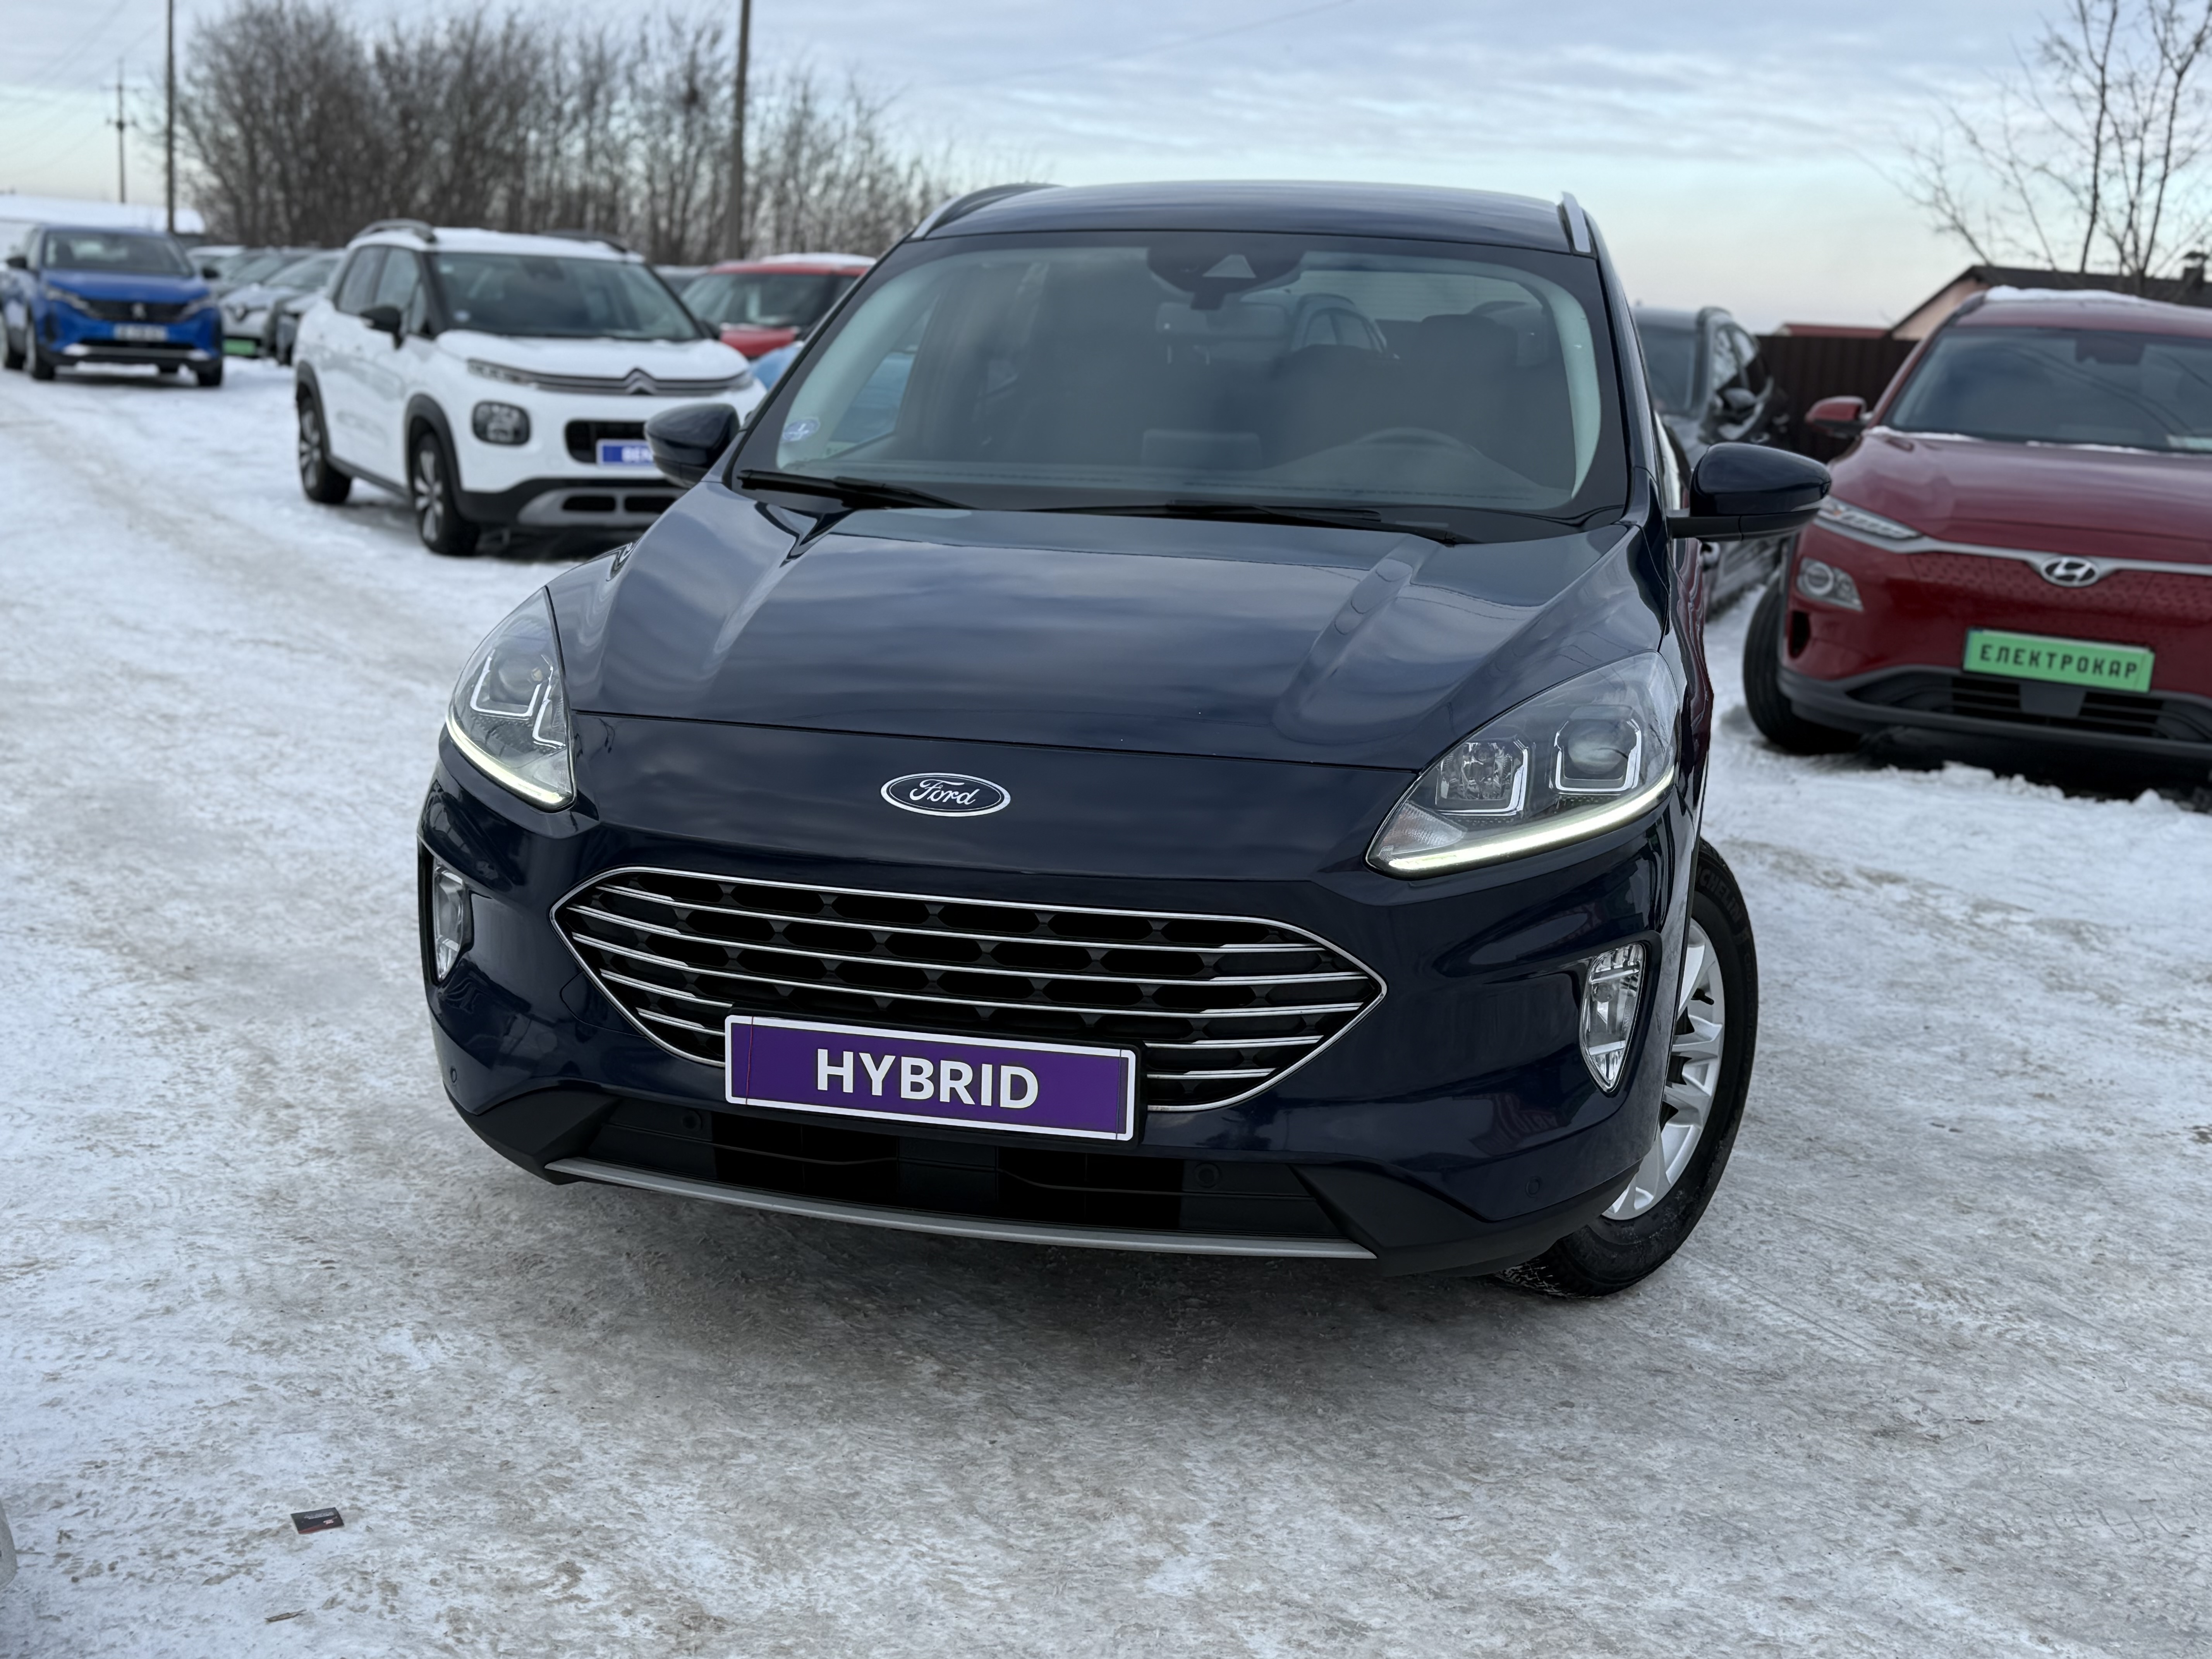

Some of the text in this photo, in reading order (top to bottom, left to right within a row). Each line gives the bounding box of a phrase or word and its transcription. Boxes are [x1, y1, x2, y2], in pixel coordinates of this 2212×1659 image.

[1980, 644, 2137, 678] ЕЛЕКТРОКАР
[909, 779, 980, 805] Ford
[1696, 864, 1742, 923] ICHELIN
[817, 1048, 1039, 1108] HYBRID
